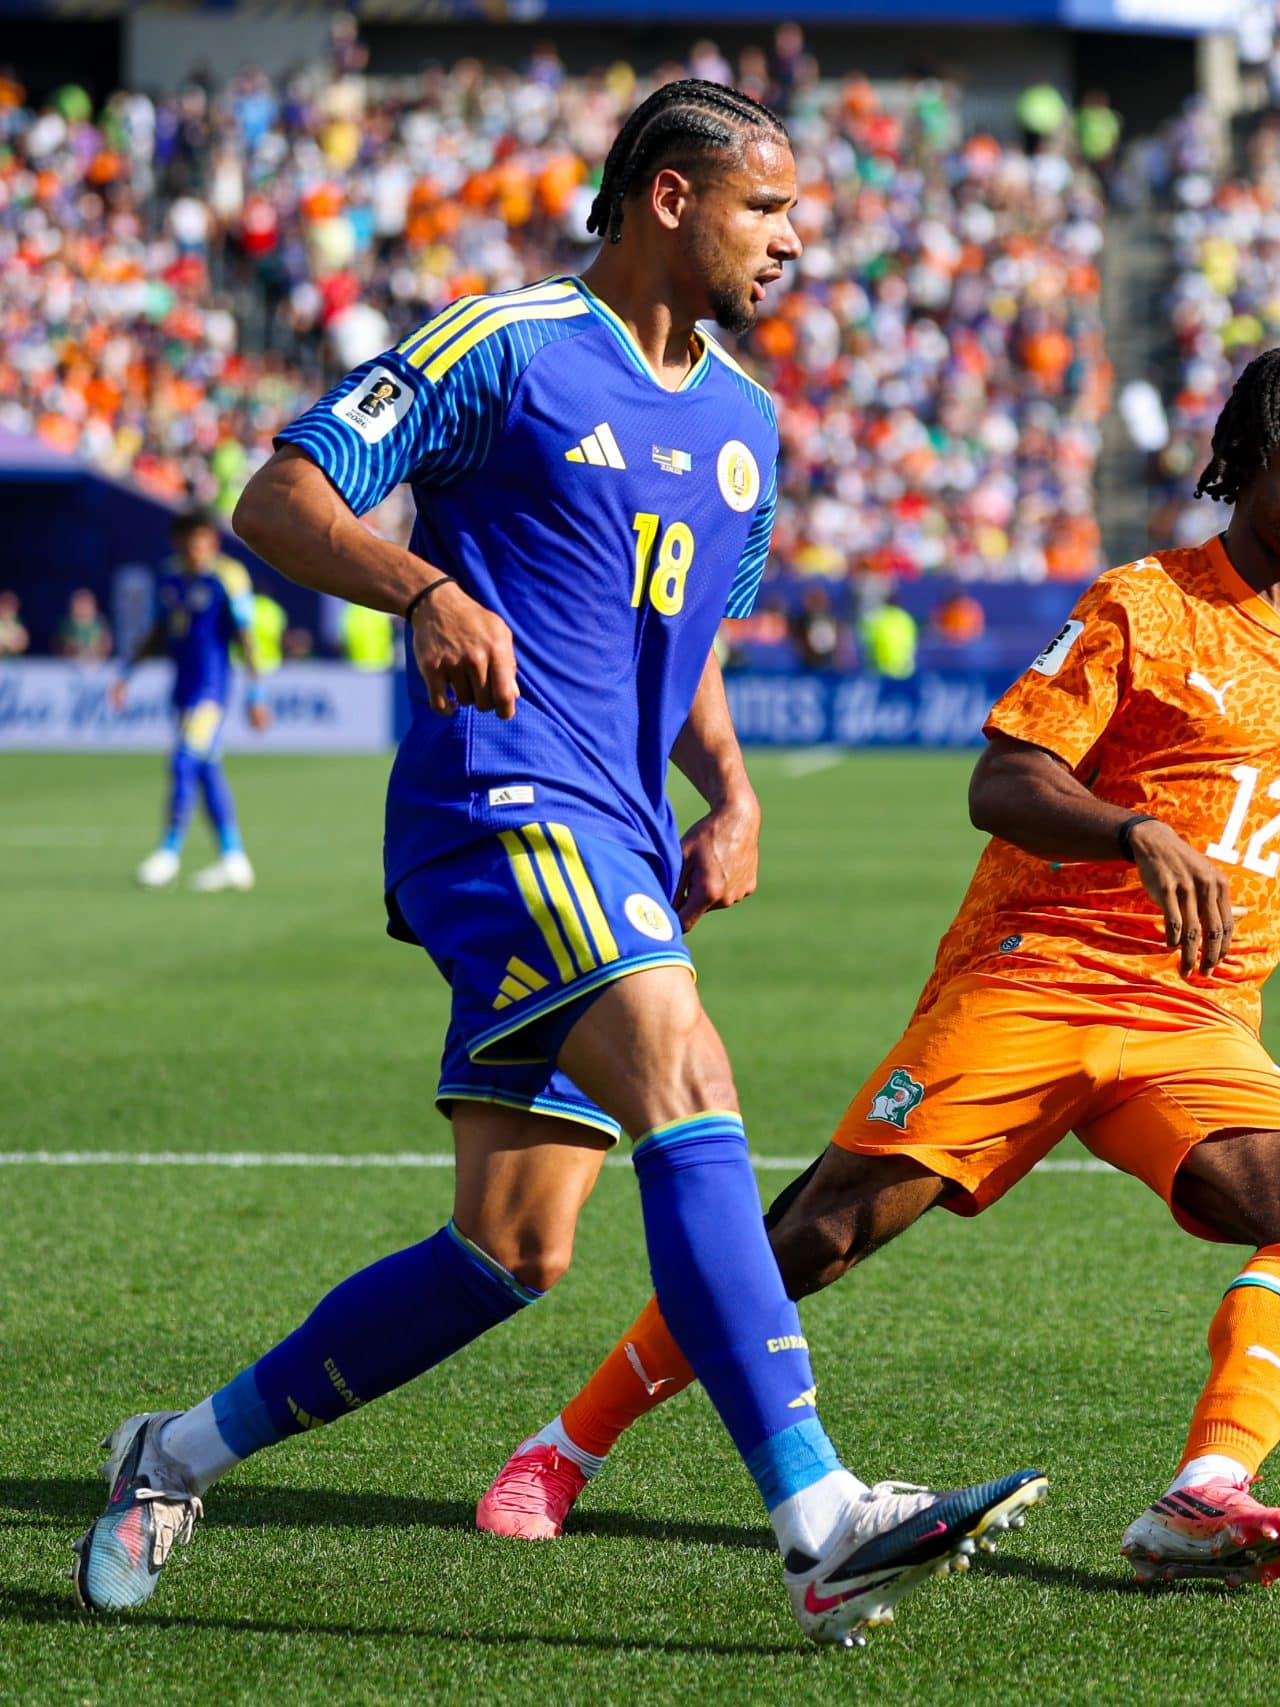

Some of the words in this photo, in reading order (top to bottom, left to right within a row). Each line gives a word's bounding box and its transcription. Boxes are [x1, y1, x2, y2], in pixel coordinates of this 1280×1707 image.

[630, 512, 695, 617] 18
[724, 676, 826, 744] ITES
[766, 1335, 809, 1353] CURA
